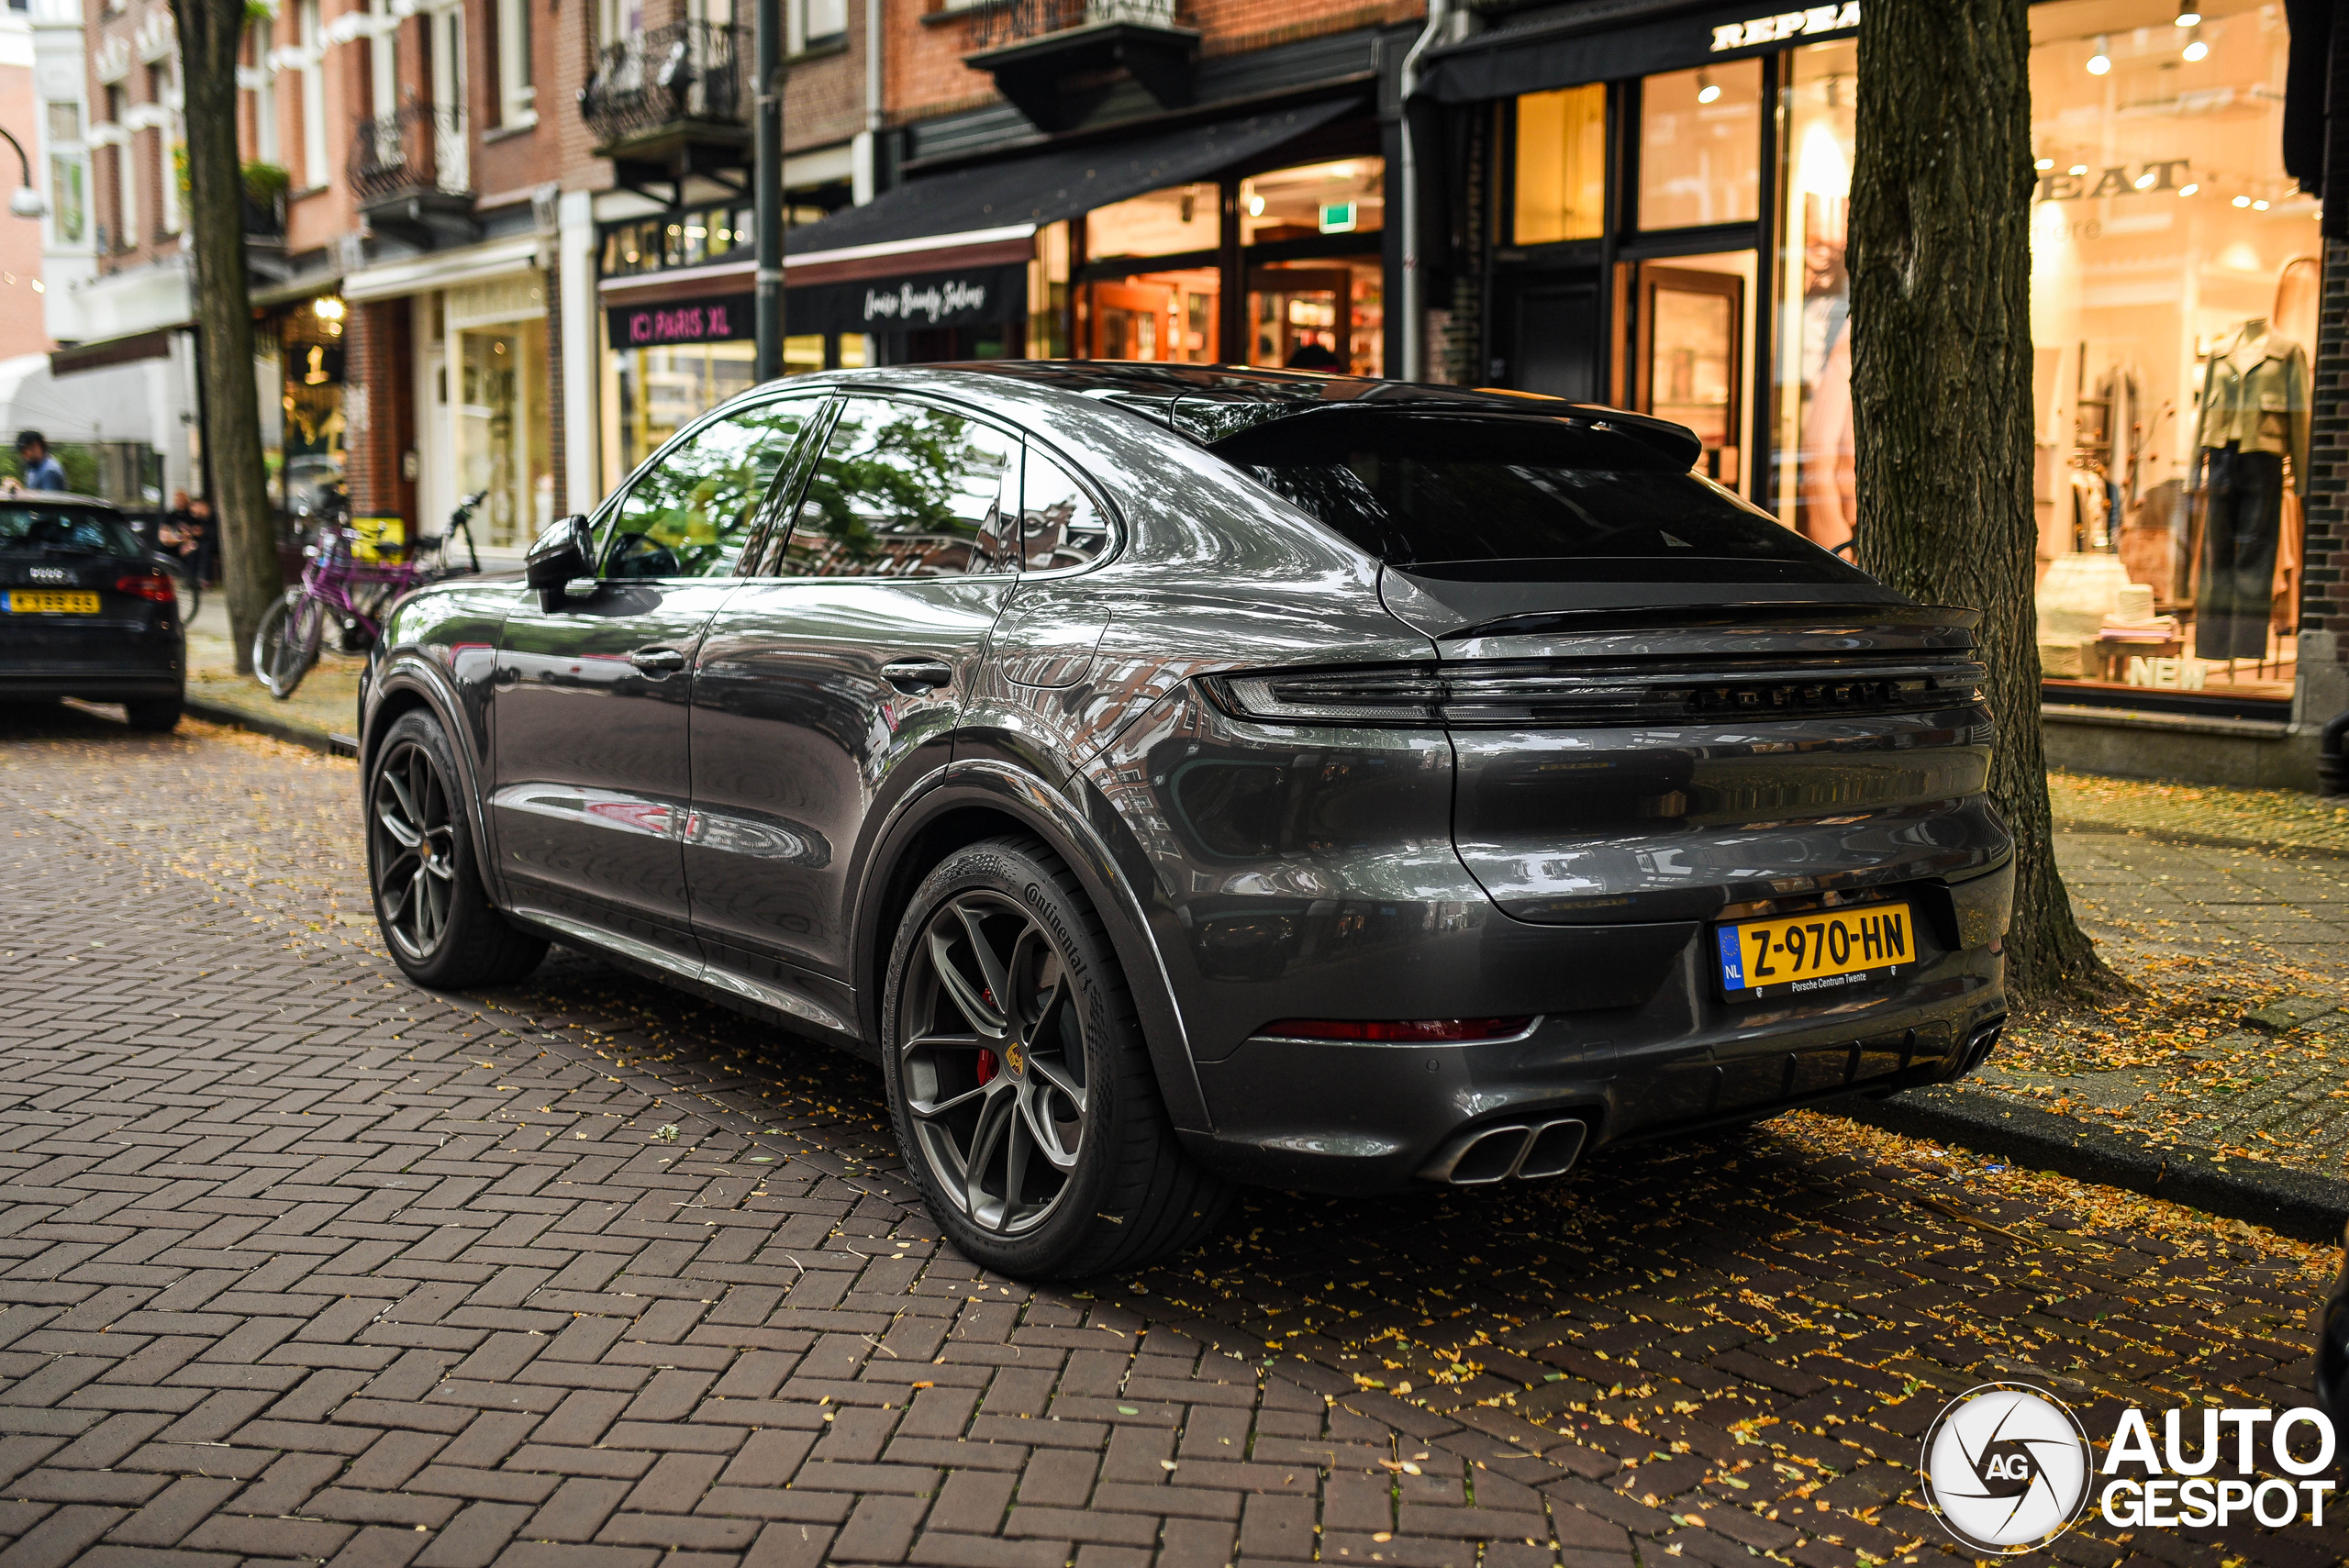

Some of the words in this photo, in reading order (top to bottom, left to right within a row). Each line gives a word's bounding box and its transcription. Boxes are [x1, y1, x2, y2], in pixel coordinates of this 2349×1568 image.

[629, 312, 653, 342] ICI
[655, 306, 704, 341] PARIS
[707, 305, 732, 337] XL
[2130, 655, 2208, 691] NEW
[1024, 882, 1087, 978] Continental
[1751, 913, 1906, 978] Z-970-HN
[1725, 964, 1742, 980] NL
[1792, 979, 1818, 993] Porsche
[1818, 975, 1845, 989] Centrum
[1845, 973, 1867, 984] Twente
